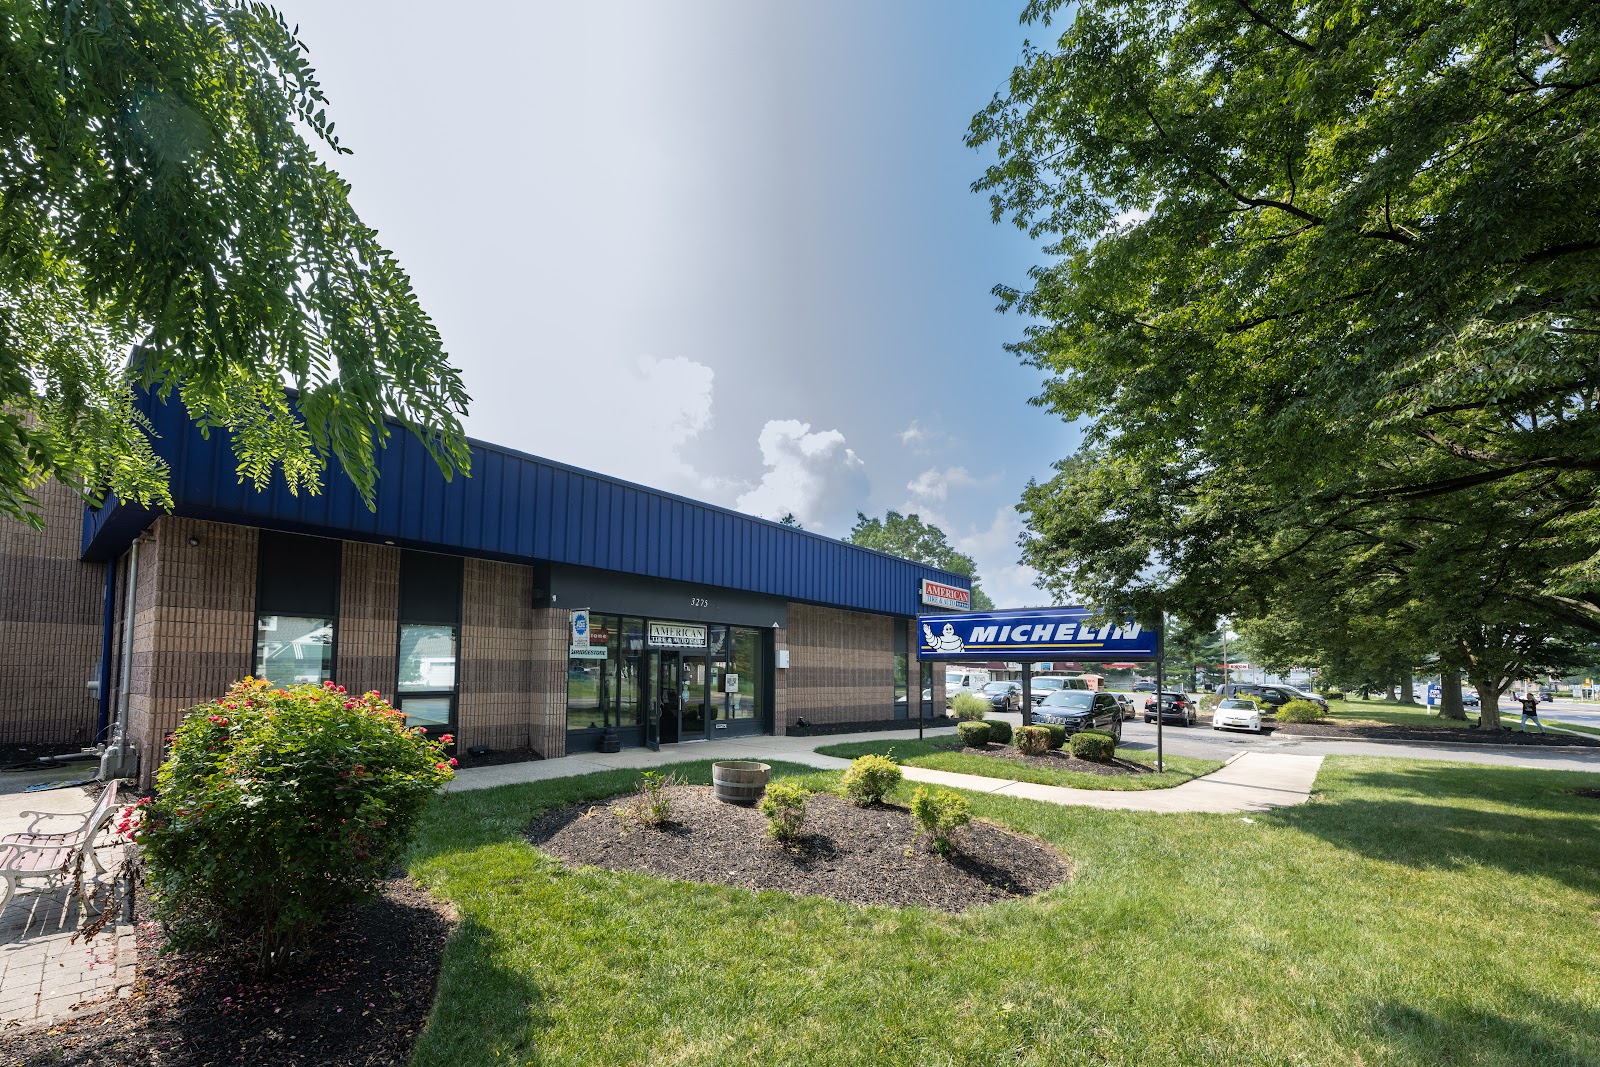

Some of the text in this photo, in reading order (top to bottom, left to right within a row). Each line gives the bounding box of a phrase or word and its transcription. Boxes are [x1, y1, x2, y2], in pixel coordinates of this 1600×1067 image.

[926, 585, 968, 602] AMERICAN
[690, 597, 708, 607] 3275
[653, 626, 703, 638] AMERICAN
[969, 622, 1142, 643] MICHELIN
